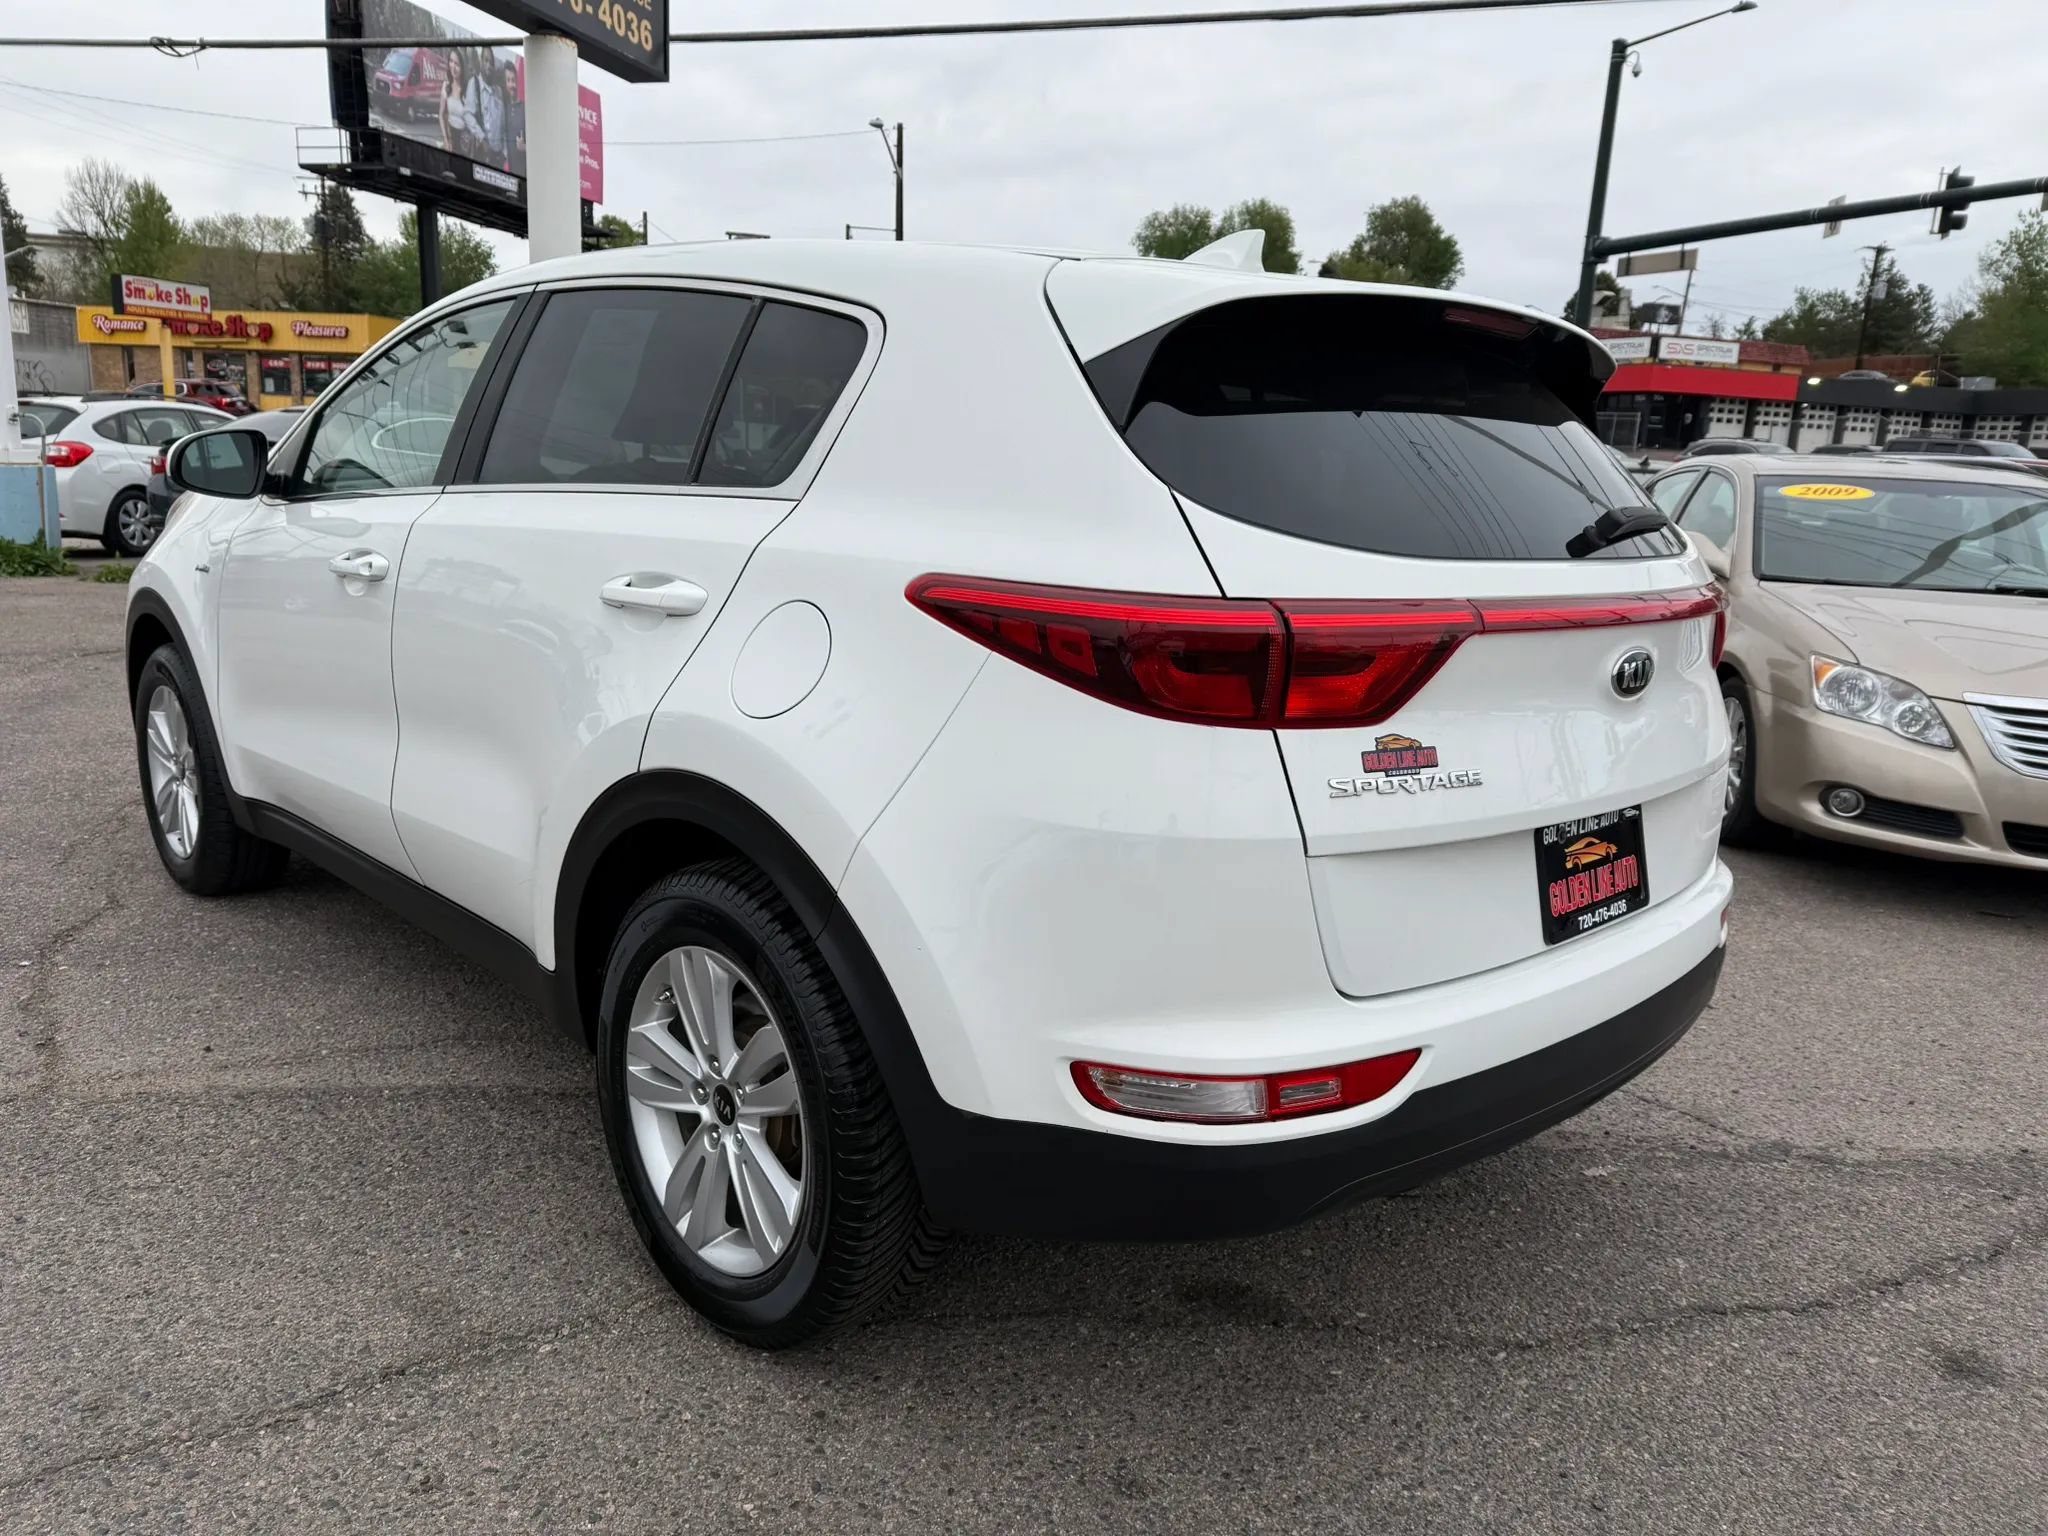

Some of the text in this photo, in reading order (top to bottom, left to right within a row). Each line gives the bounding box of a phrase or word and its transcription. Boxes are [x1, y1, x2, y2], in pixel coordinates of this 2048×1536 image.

[93, 315, 145, 334] Romance
[225, 314, 273, 343] Shop
[292, 320, 348, 338] Pleasures
[1797, 487, 1858, 496] 2009
[1363, 748, 1438, 771] GOLDEN LINE AUTO
[1328, 769, 1483, 798] SPORTAGE
[1579, 816, 1599, 834] LINE
[1549, 854, 1638, 917] GOLDEN LINE AUTO
[1578, 899, 1627, 930] 720-476-4036
